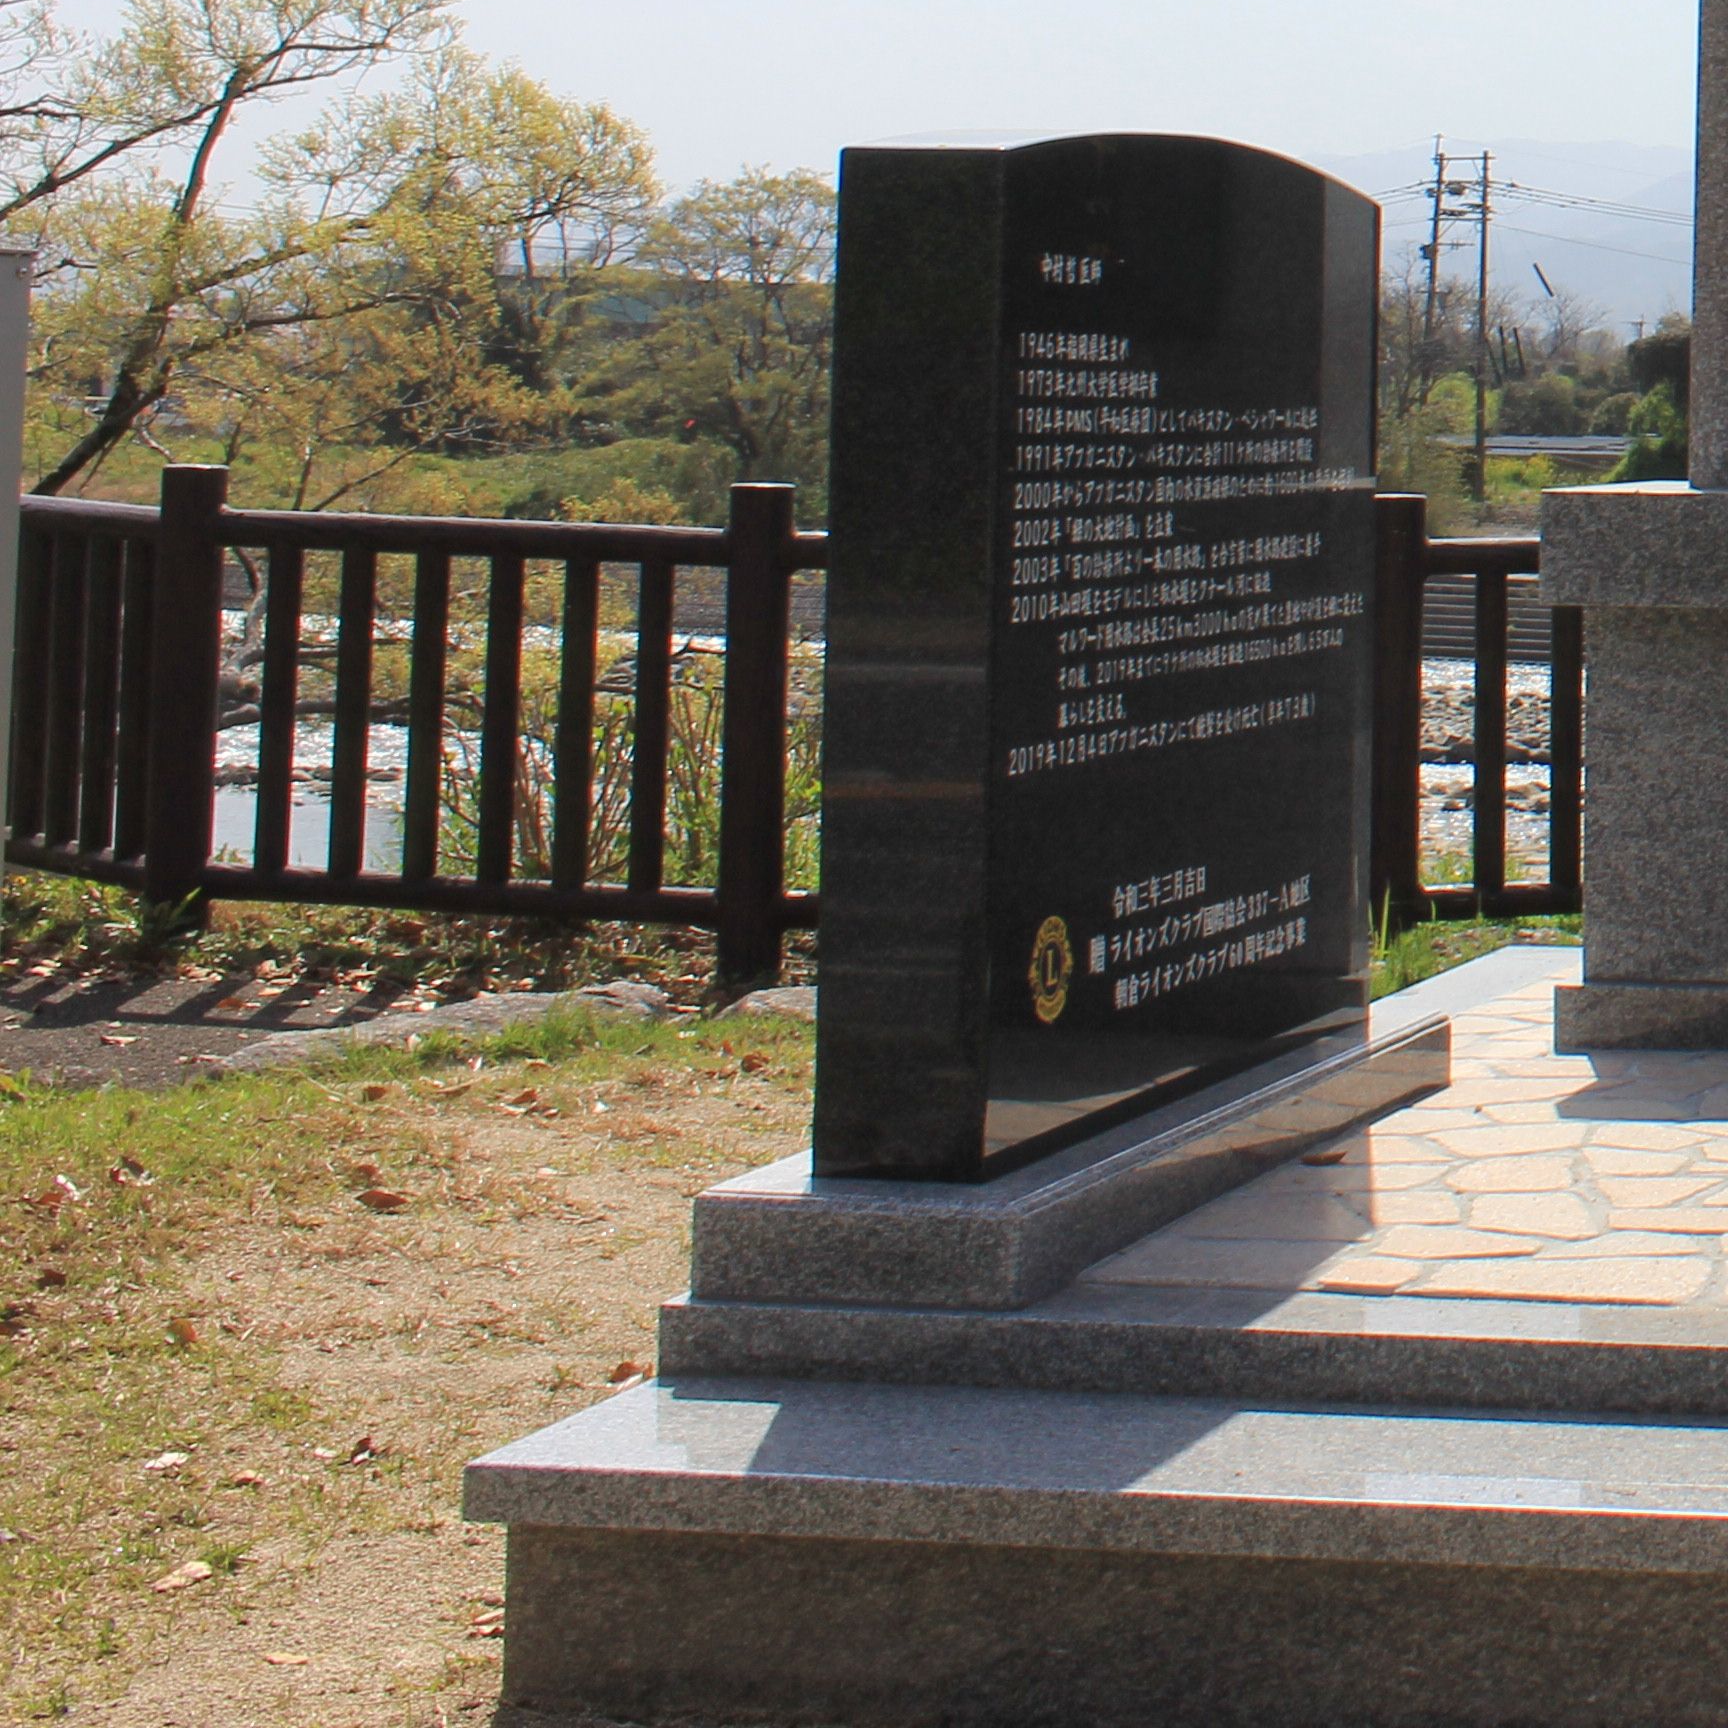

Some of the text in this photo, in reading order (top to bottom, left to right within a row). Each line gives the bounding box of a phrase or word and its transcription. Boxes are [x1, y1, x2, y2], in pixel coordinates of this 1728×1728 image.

[1018, 332, 1130, 362] 1946年福岡県生まれ
[1018, 371, 1159, 399] 1973年九州大学医学部卒業
[1111, 864, 1207, 919] 令和三年三月吉日
[1113, 915, 1307, 1011] 朝倉ライオンズクラブ60周年記念事業
